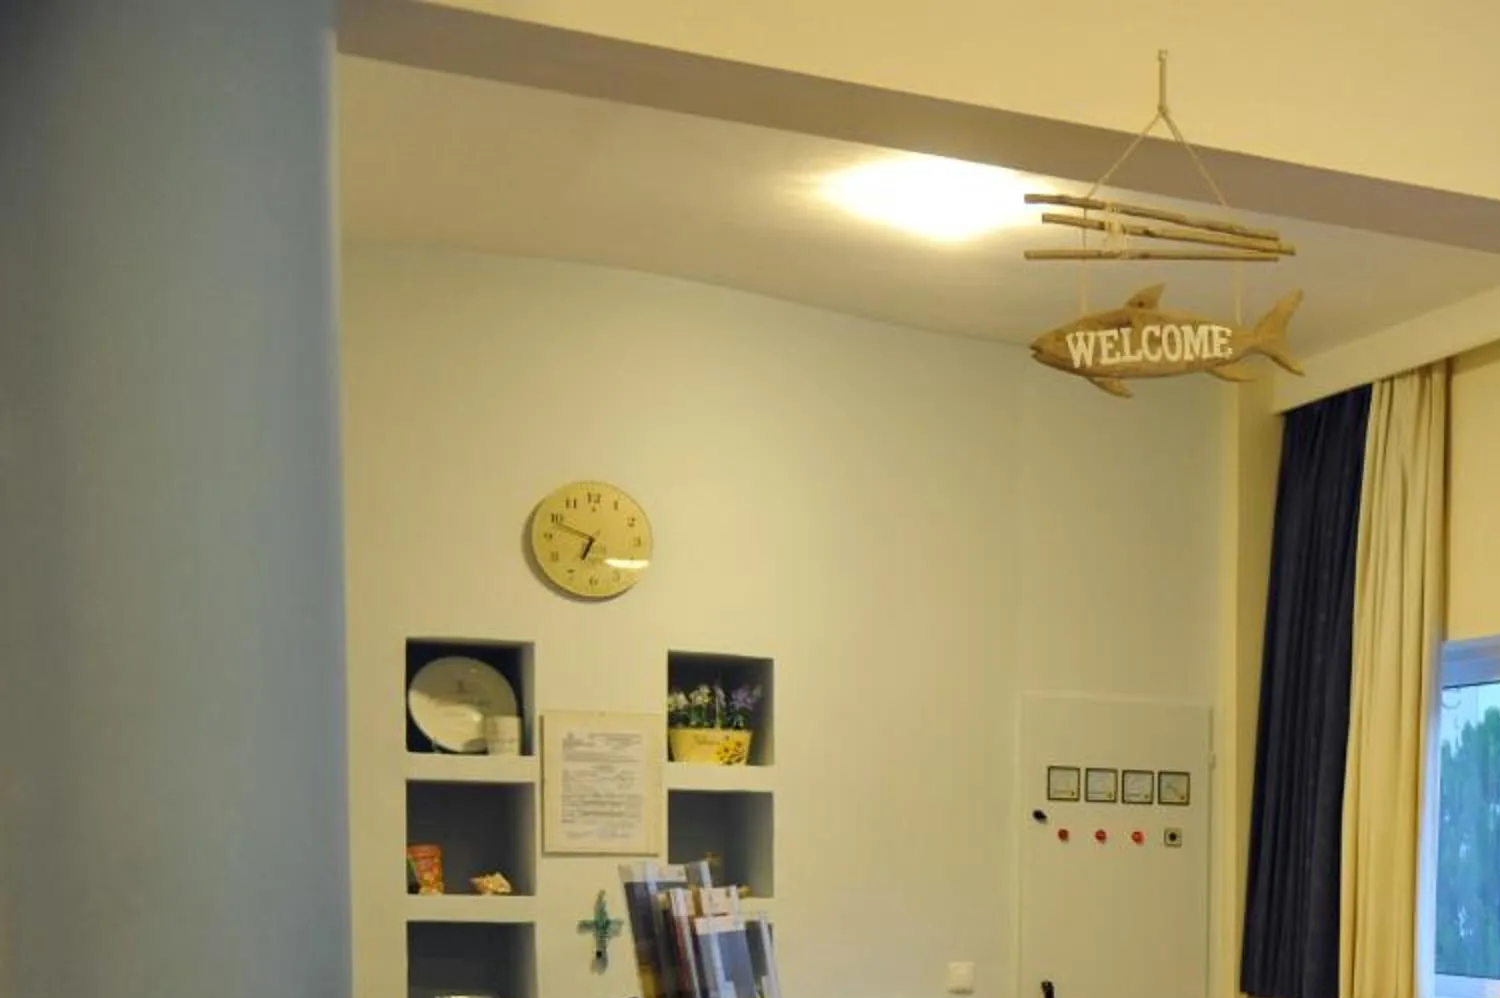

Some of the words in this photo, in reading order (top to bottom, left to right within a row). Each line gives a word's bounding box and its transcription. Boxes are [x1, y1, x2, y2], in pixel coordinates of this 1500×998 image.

[1065, 323, 1233, 368] WELCOME
[565, 497, 577, 509] 11
[587, 492, 601, 504] 12
[551, 512, 564, 523] 10
[627, 517, 636, 528] 2
